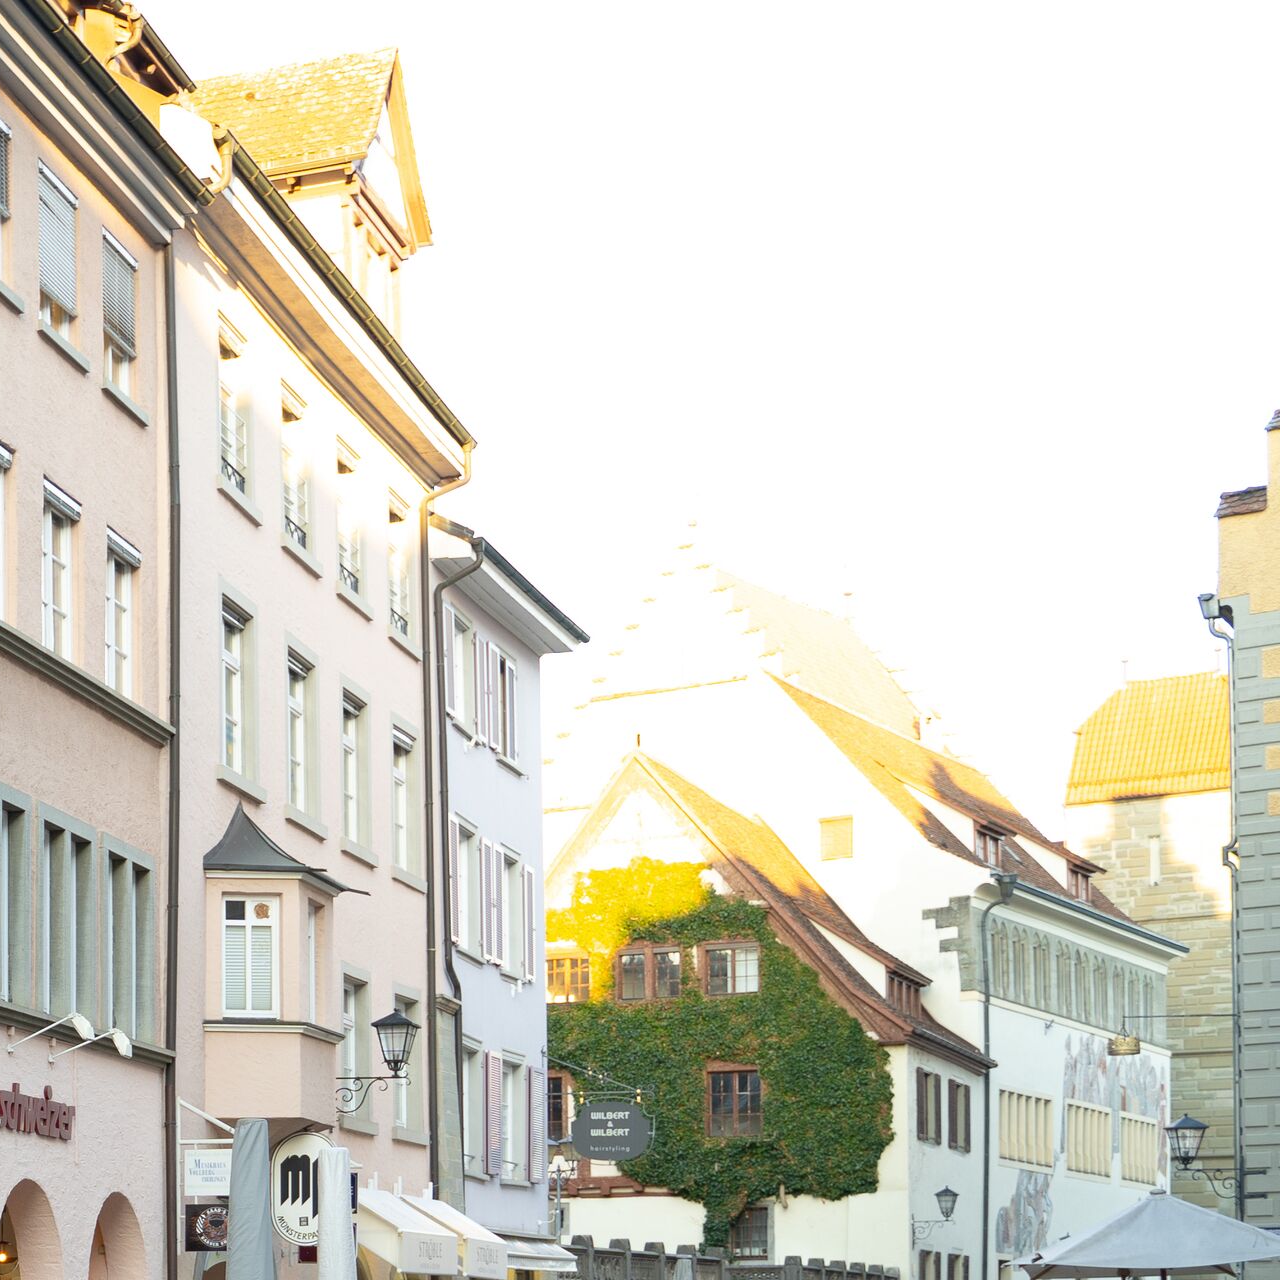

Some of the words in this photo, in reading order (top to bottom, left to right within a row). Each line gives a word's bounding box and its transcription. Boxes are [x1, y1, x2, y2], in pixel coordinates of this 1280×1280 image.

[590, 1111, 630, 1120] WILBERT
[607, 1120, 614, 1128] &
[590, 1128, 630, 1137] WILBERT
[277, 1215, 319, 1240] MÜNSTERPA
